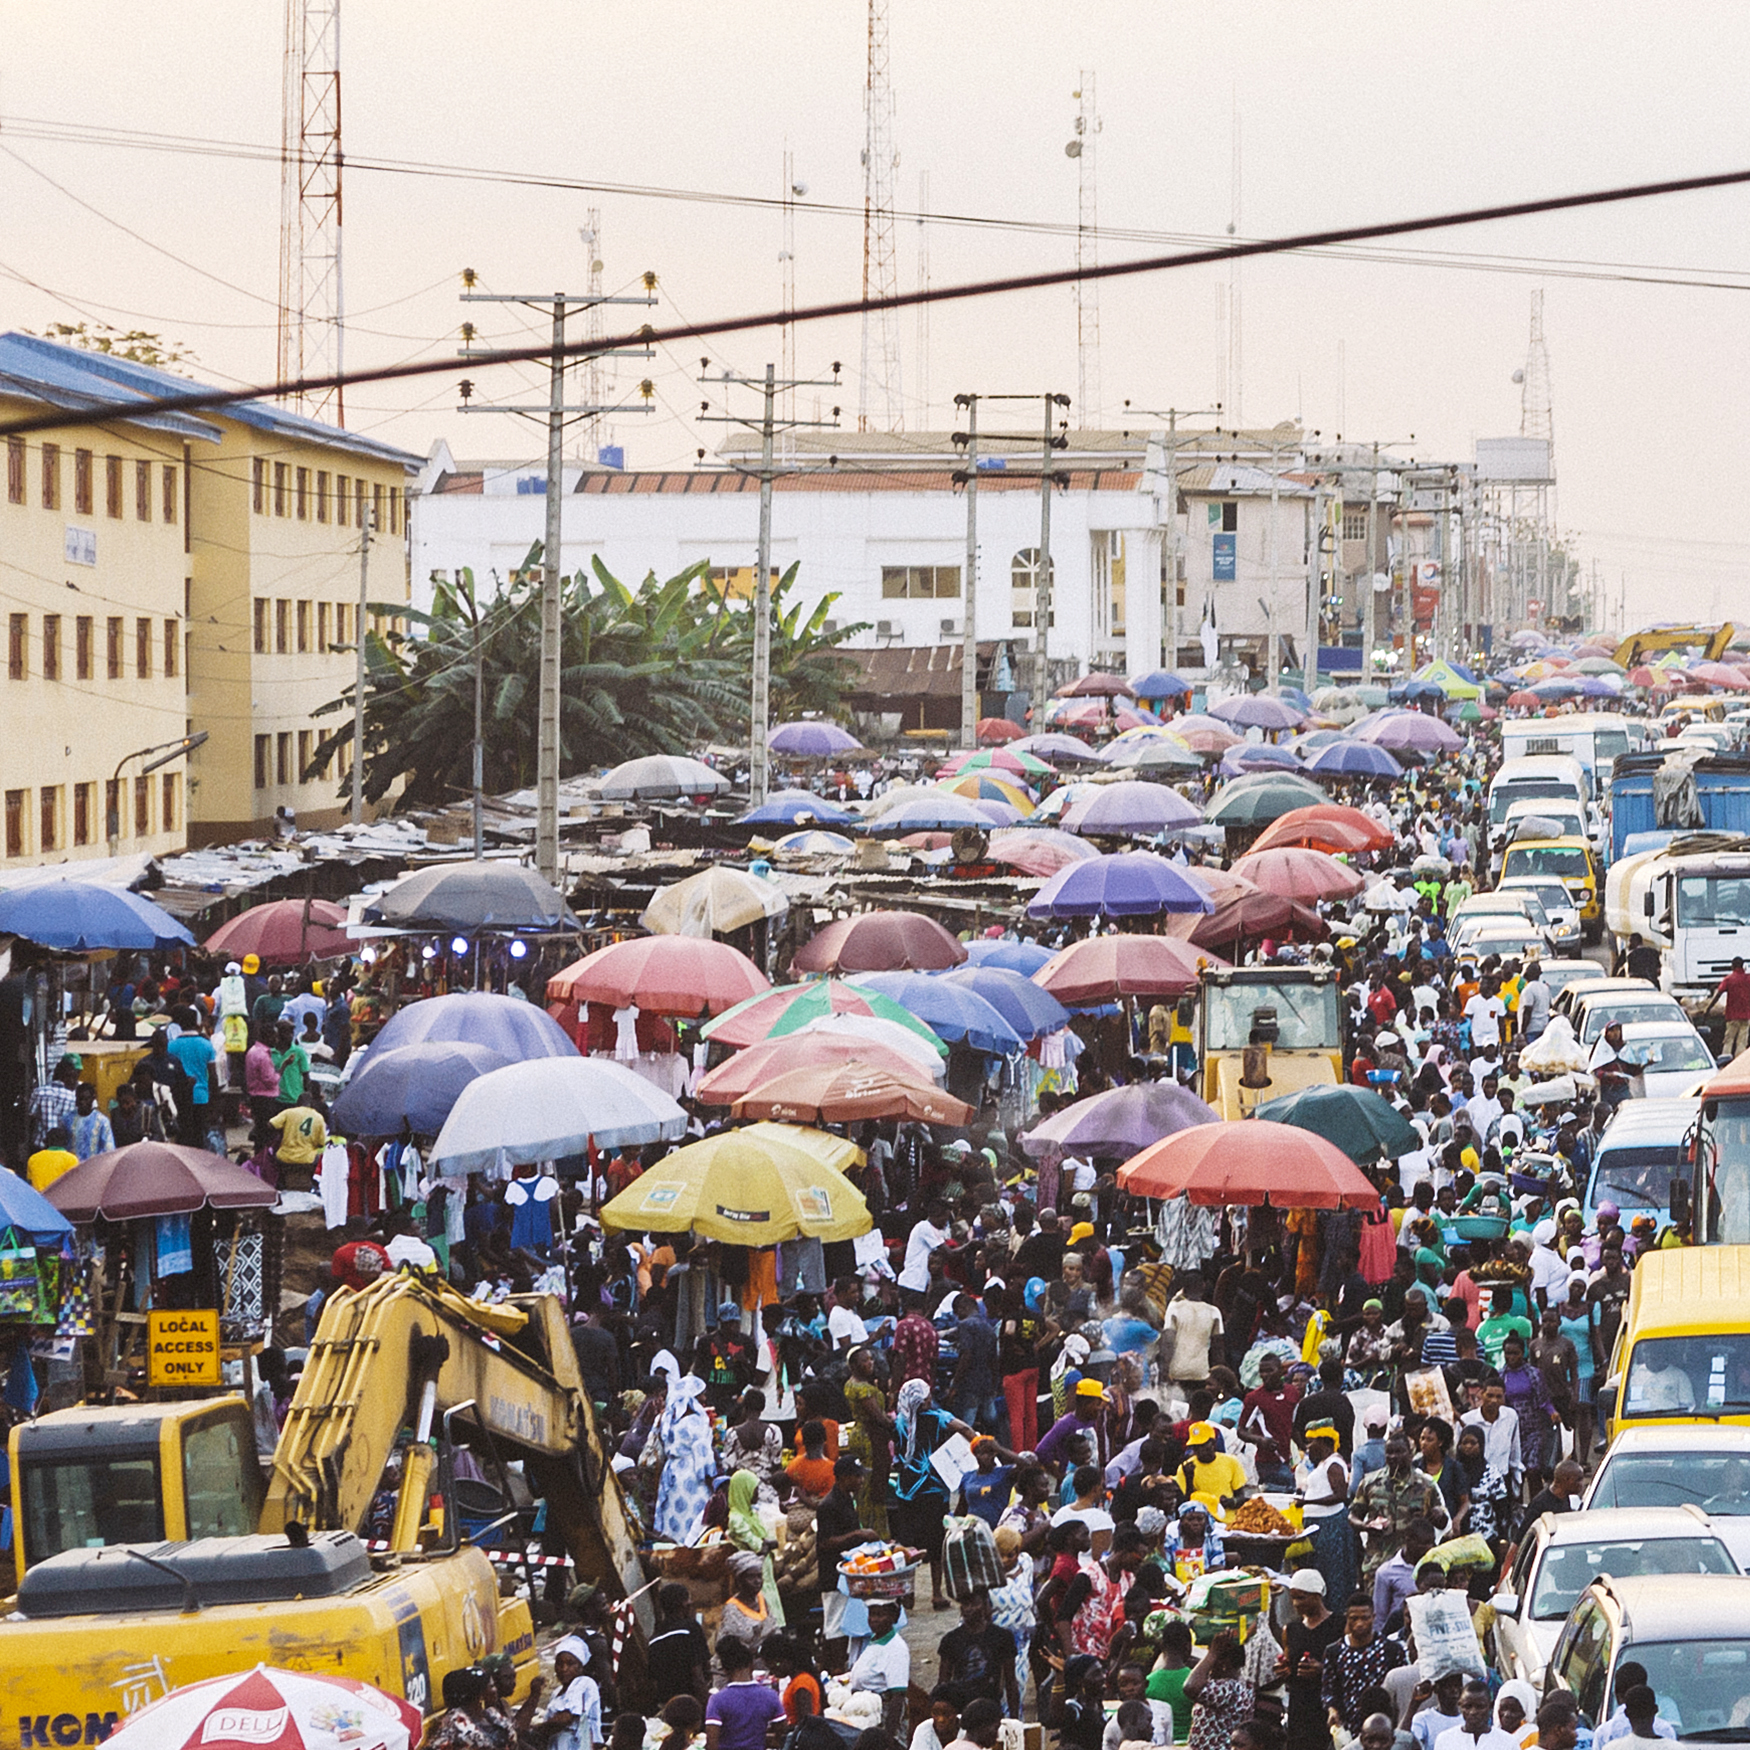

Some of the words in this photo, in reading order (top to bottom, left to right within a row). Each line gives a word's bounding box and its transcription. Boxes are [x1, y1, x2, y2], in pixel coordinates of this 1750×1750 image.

[299, 1117, 313, 1137] 4
[159, 1321, 208, 1333] LOCAL
[154, 1341, 214, 1354] ACCESS
[164, 1362, 205, 1374] ONLY
